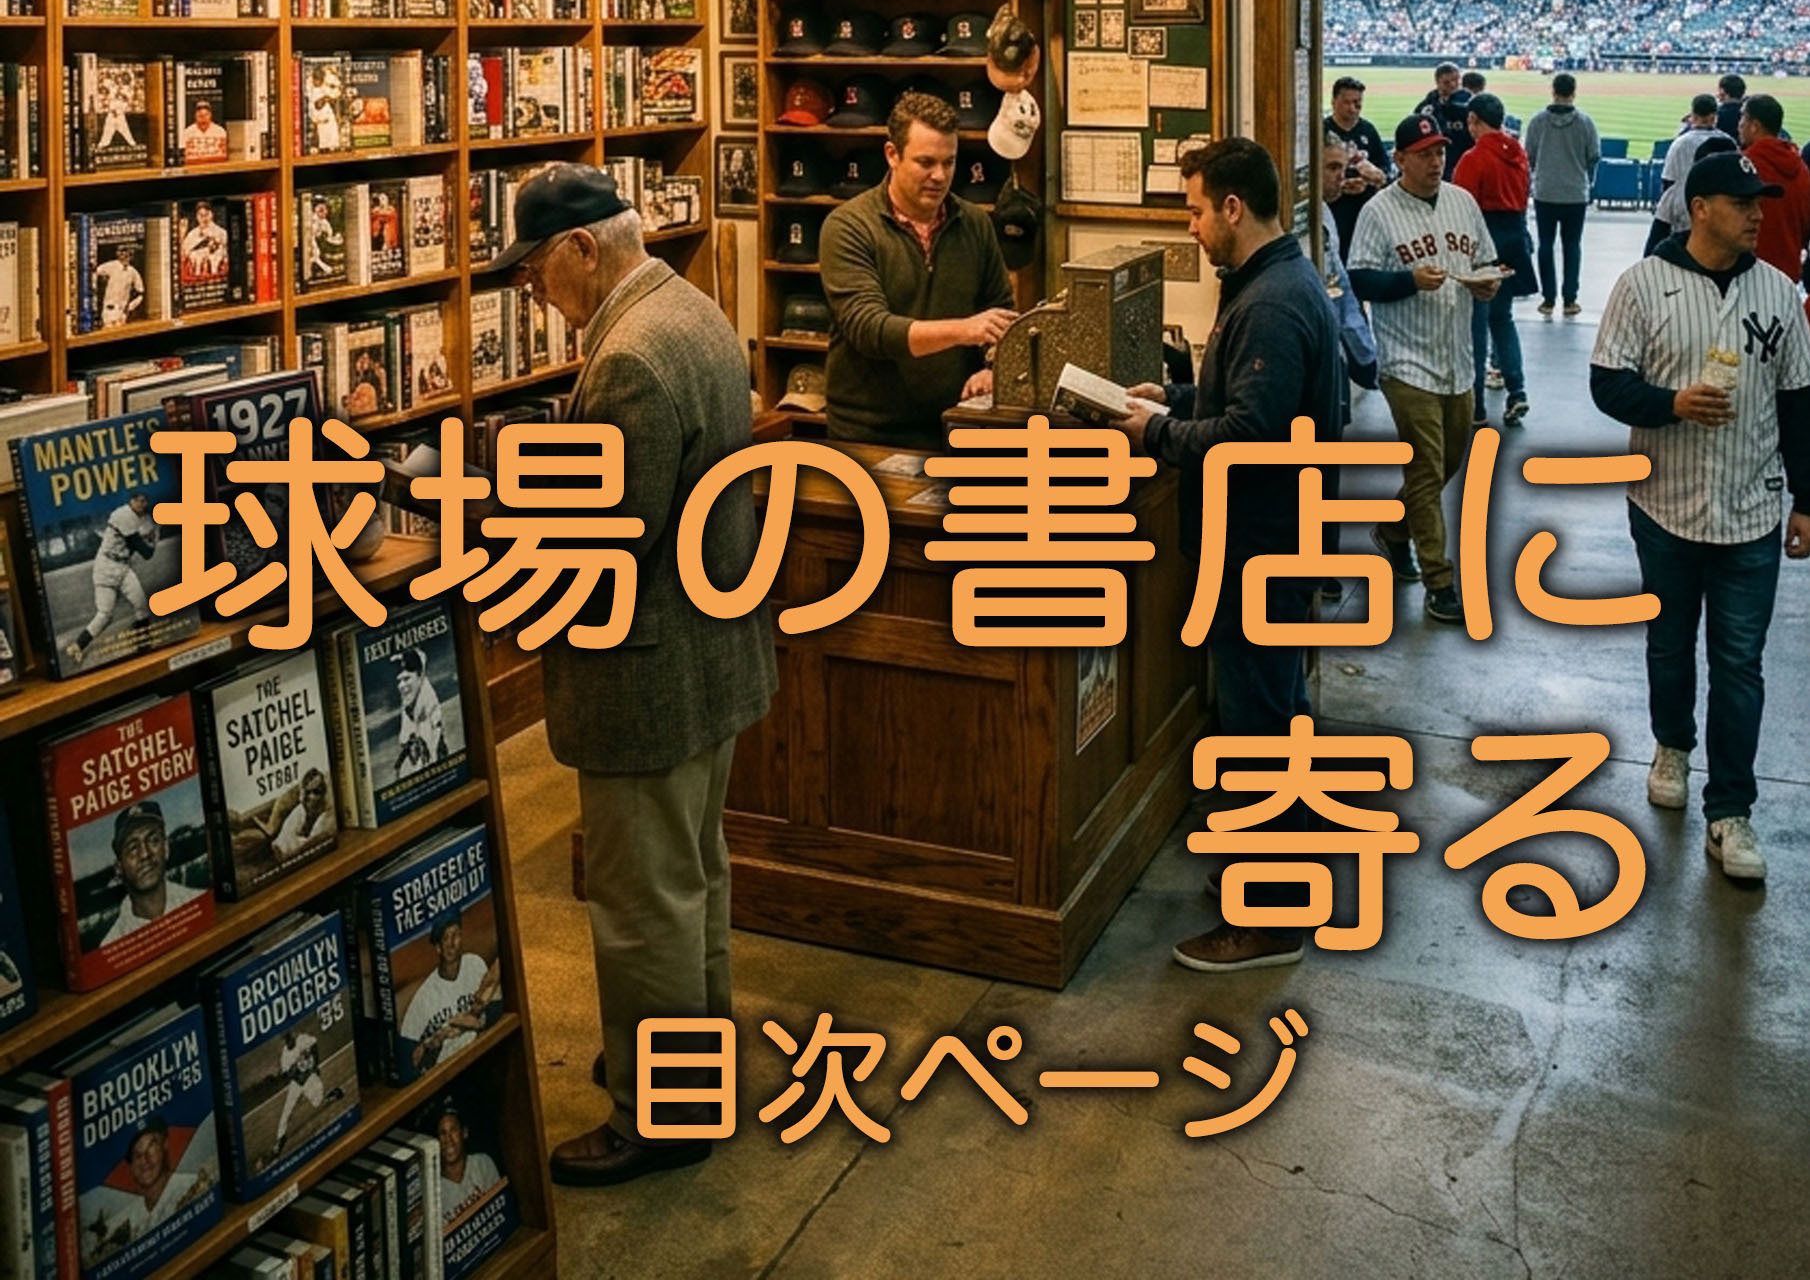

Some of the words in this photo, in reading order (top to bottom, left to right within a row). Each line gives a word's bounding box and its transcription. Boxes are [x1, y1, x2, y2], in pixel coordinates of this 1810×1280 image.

[1741, 310, 1785, 364] NY
[211, 386, 310, 446] 1927
[51, 454, 160, 507] POWER
[226, 688, 316, 748] SATCHEL
[81, 725, 183, 786] SATCHEL
[69, 773, 134, 821] PAIGE
[239, 961, 342, 1045] DODGERS
[81, 1029, 200, 1121] BROOKLYN
